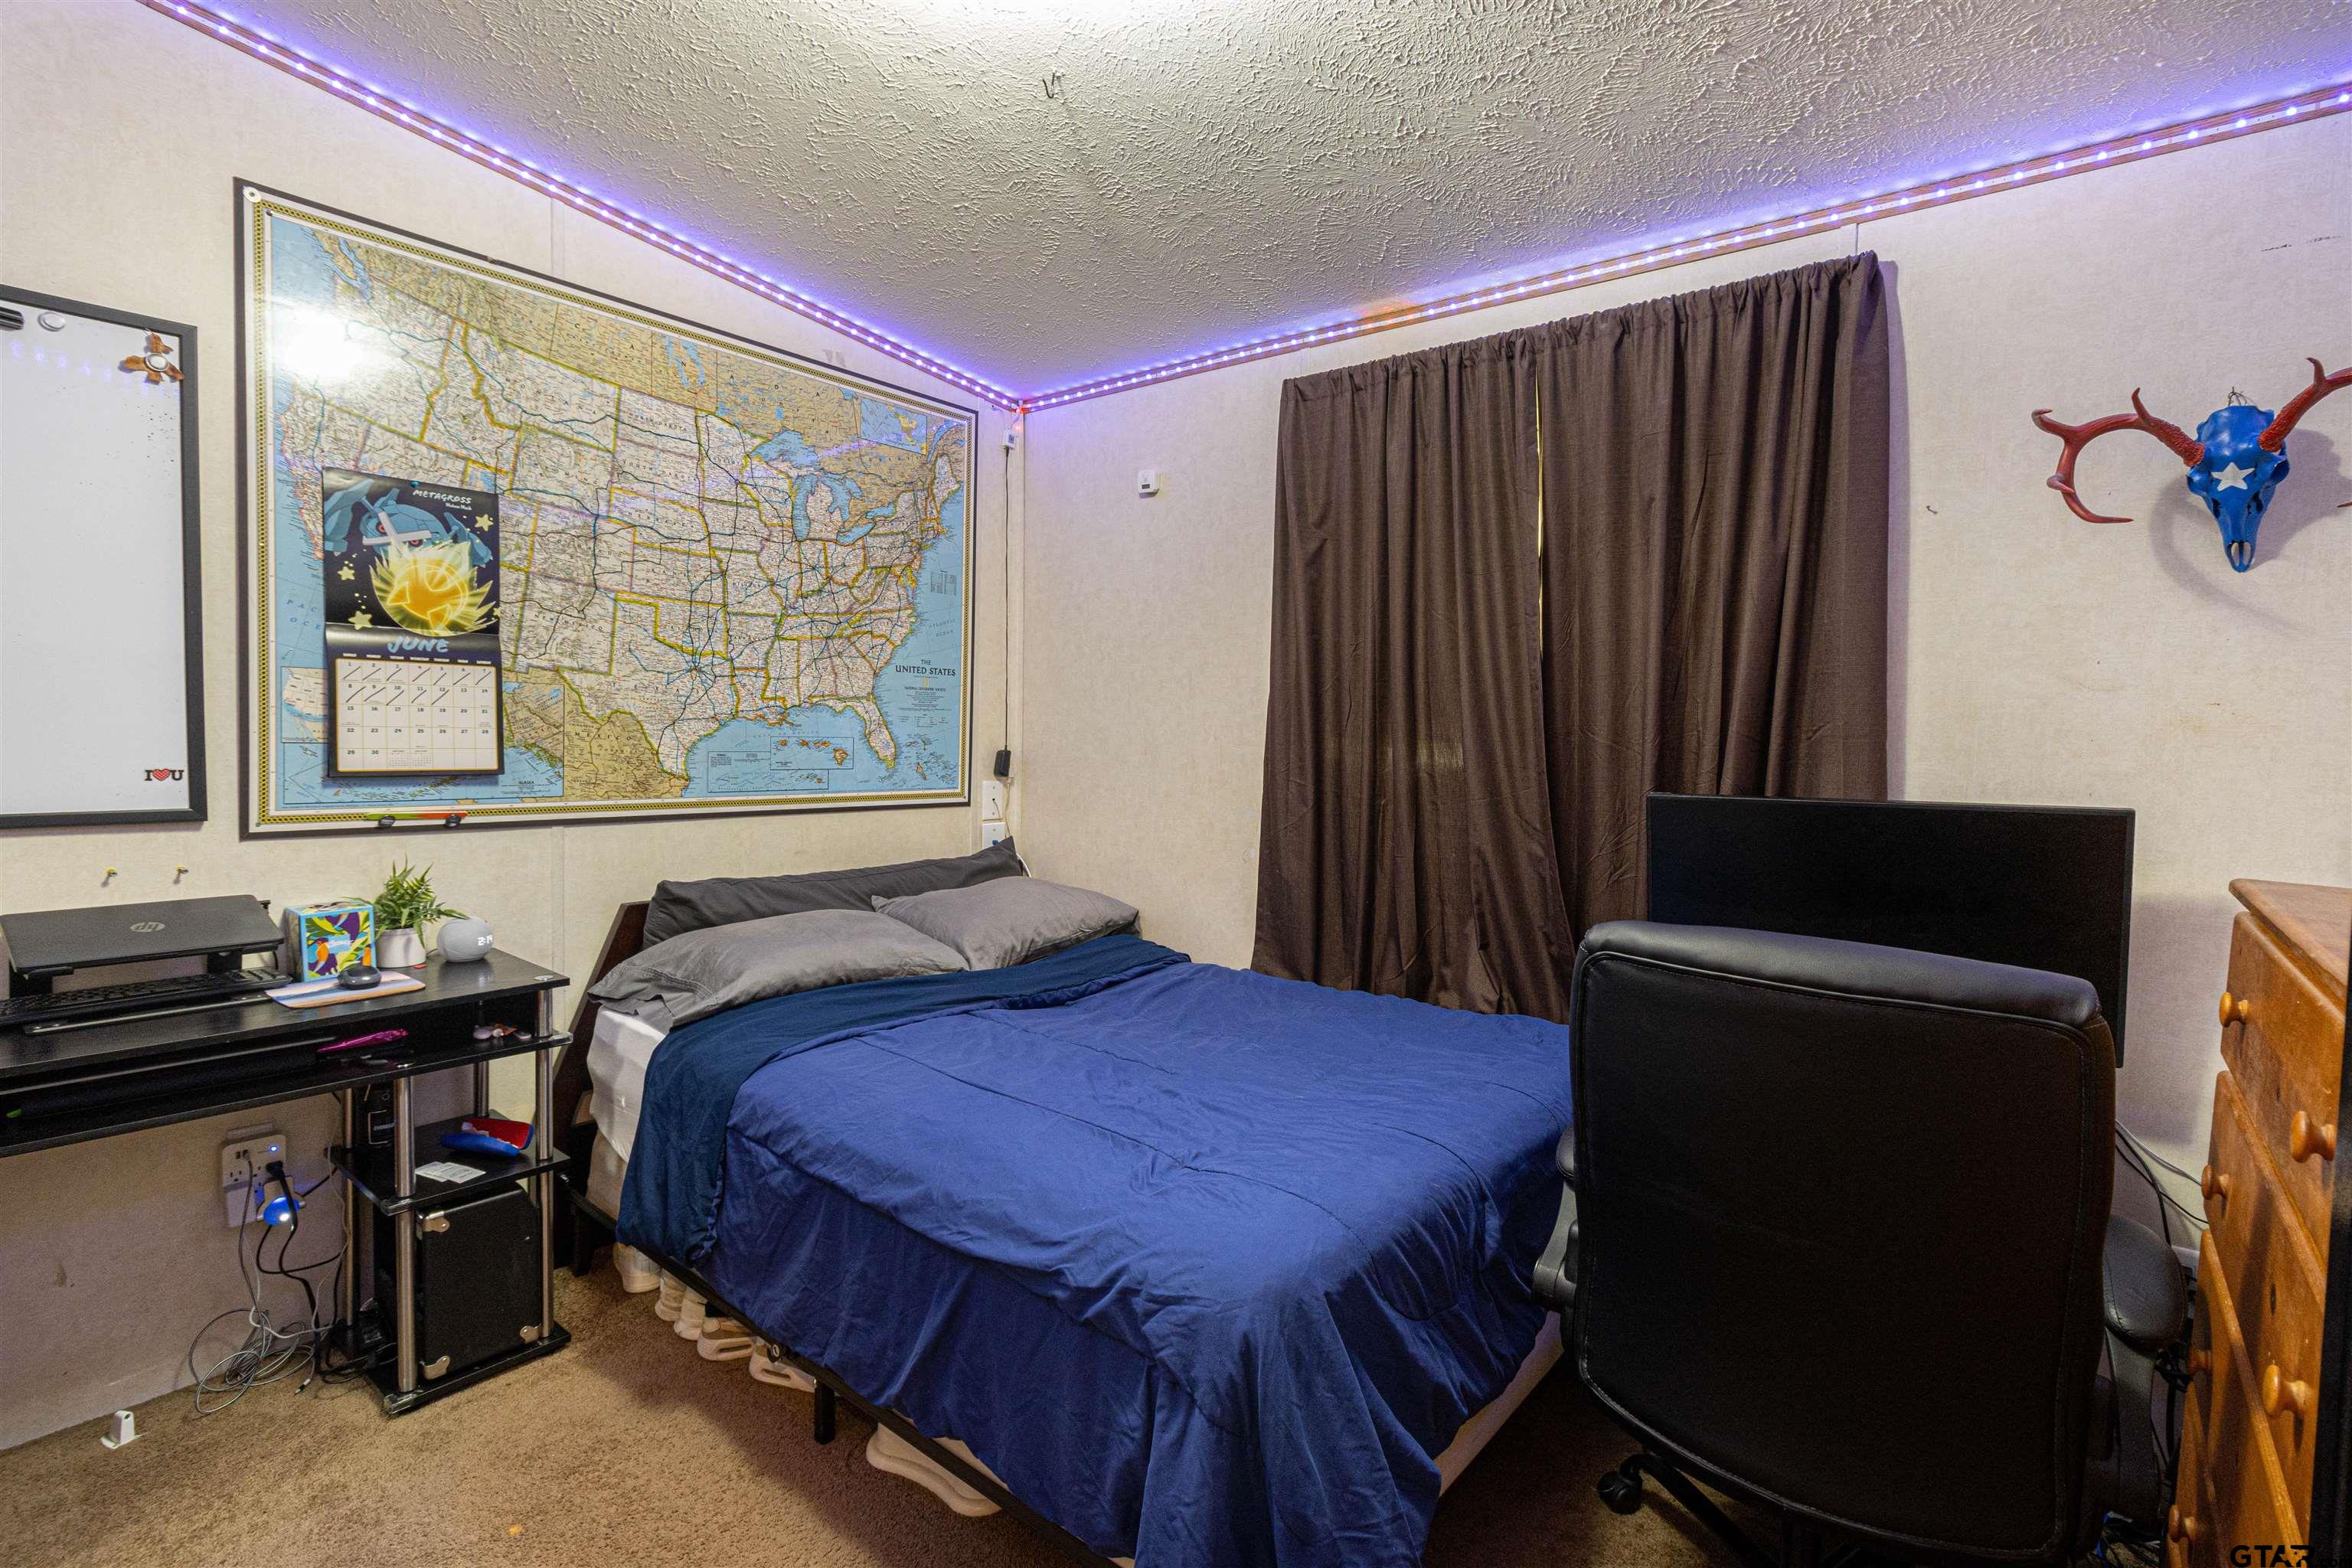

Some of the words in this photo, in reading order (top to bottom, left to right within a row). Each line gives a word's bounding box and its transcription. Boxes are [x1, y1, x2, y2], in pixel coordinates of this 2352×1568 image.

[413, 490, 472, 504] METAGROSS
[387, 635, 449, 653] JUNE
[895, 665, 927, 675] UNITED
[929, 667, 956, 677] STATES
[145, 769, 153, 781] I
[171, 769, 184, 781] U
